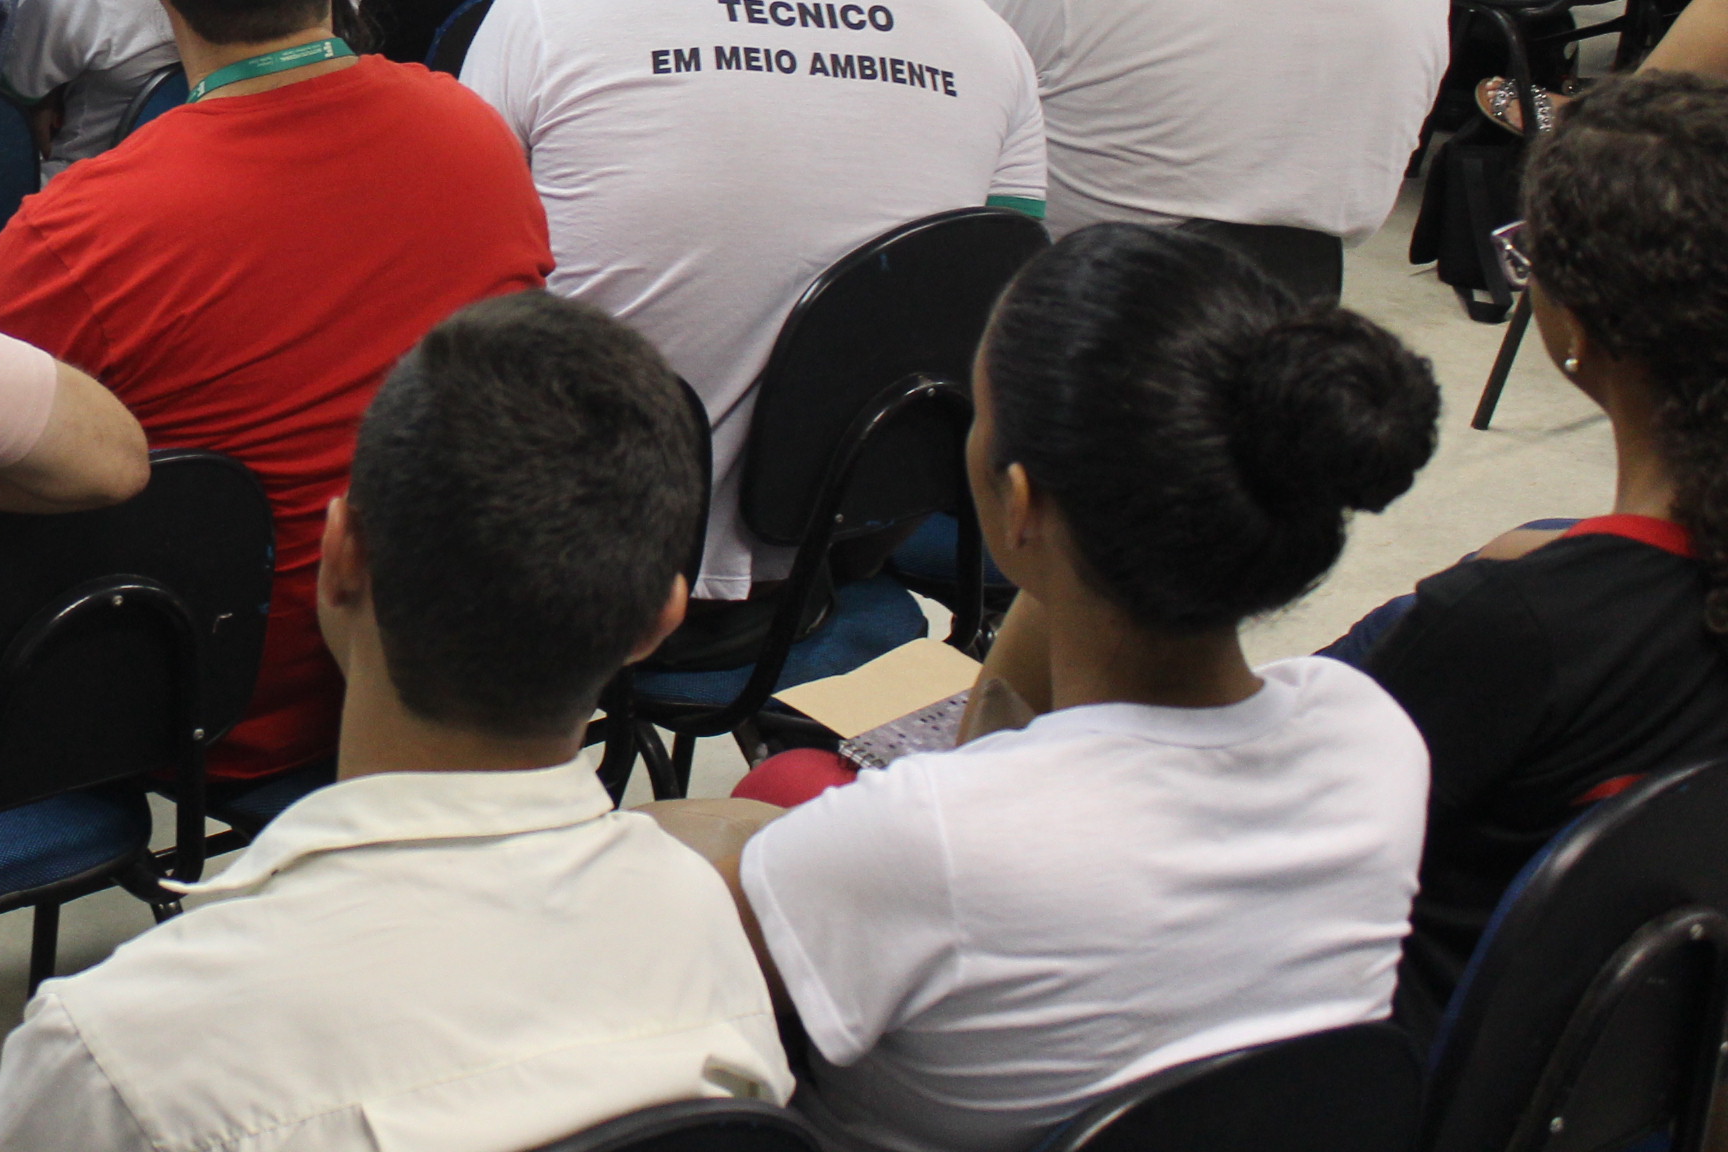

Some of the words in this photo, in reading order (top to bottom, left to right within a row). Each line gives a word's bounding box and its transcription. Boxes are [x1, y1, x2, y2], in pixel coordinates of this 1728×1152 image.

[651, 47, 701, 75] EM
[714, 46, 798, 75] MEIO
[809, 52, 957, 97] AMBIENTE
